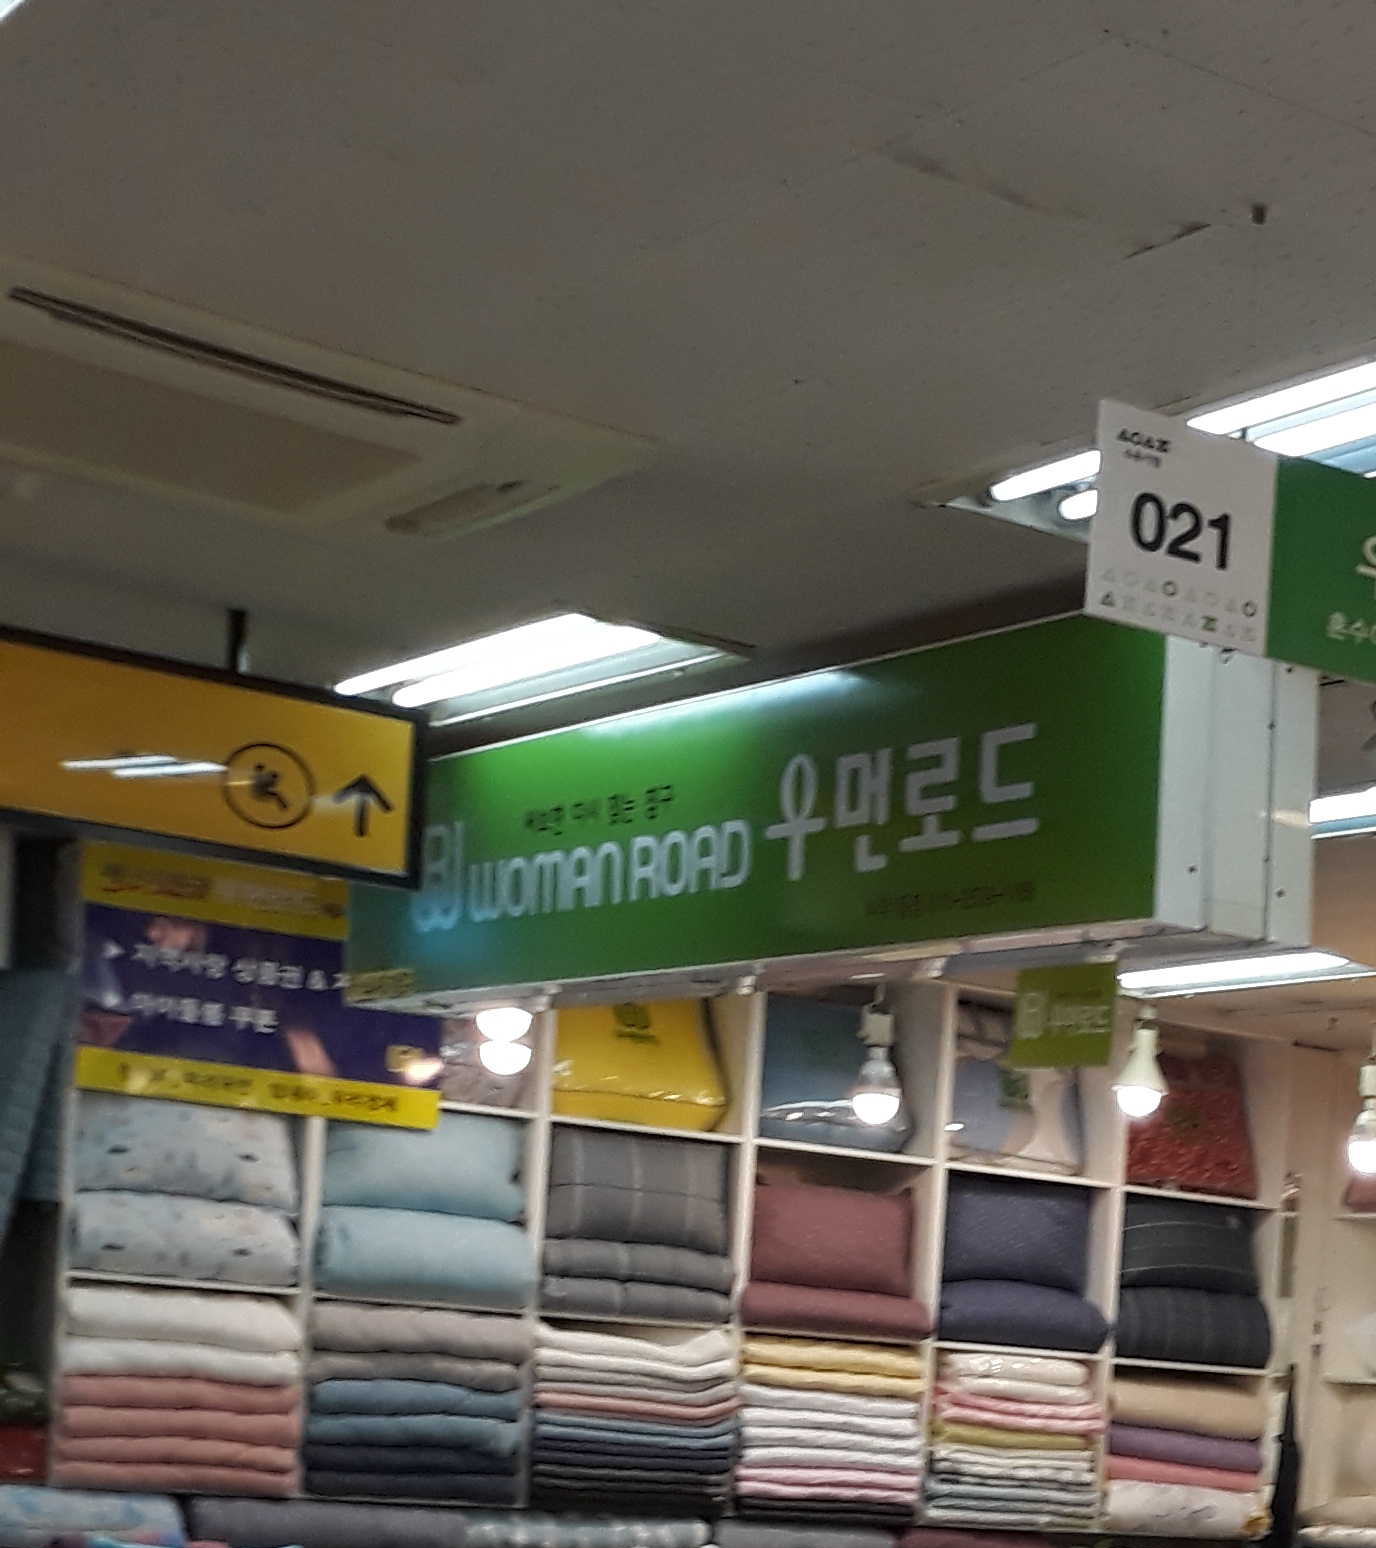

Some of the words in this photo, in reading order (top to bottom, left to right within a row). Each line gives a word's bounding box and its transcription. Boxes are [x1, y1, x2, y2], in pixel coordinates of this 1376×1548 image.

[1130, 491, 1231, 570] 021
[764, 722, 1041, 882] 우먼로드
[629, 819, 751, 901] ROAD
